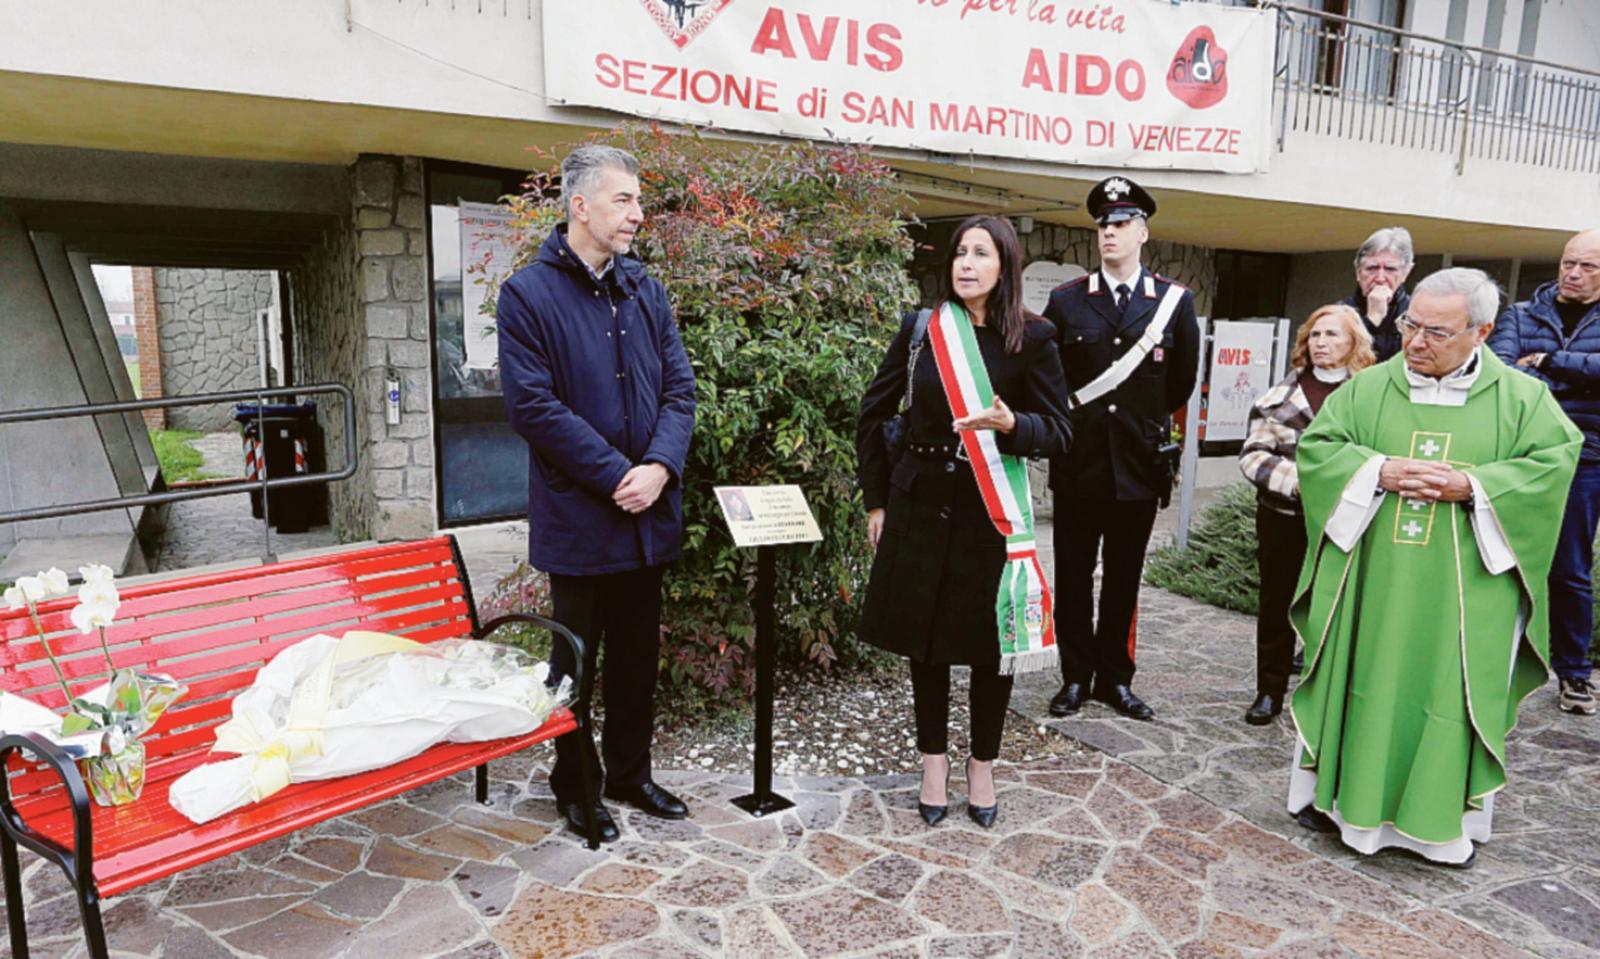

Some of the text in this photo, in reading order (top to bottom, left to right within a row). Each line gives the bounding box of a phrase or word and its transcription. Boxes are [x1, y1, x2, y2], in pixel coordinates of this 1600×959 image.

[750, 6, 903, 72] AVIS
[1027, 0, 1056, 24] la
[1066, 4, 1125, 34] vita
[1021, 47, 1146, 102] AIDO
[595, 53, 1241, 155] SEZIONE di SAN MARTINO DI VENEZZE
[1217, 348, 1251, 365] AVIS
